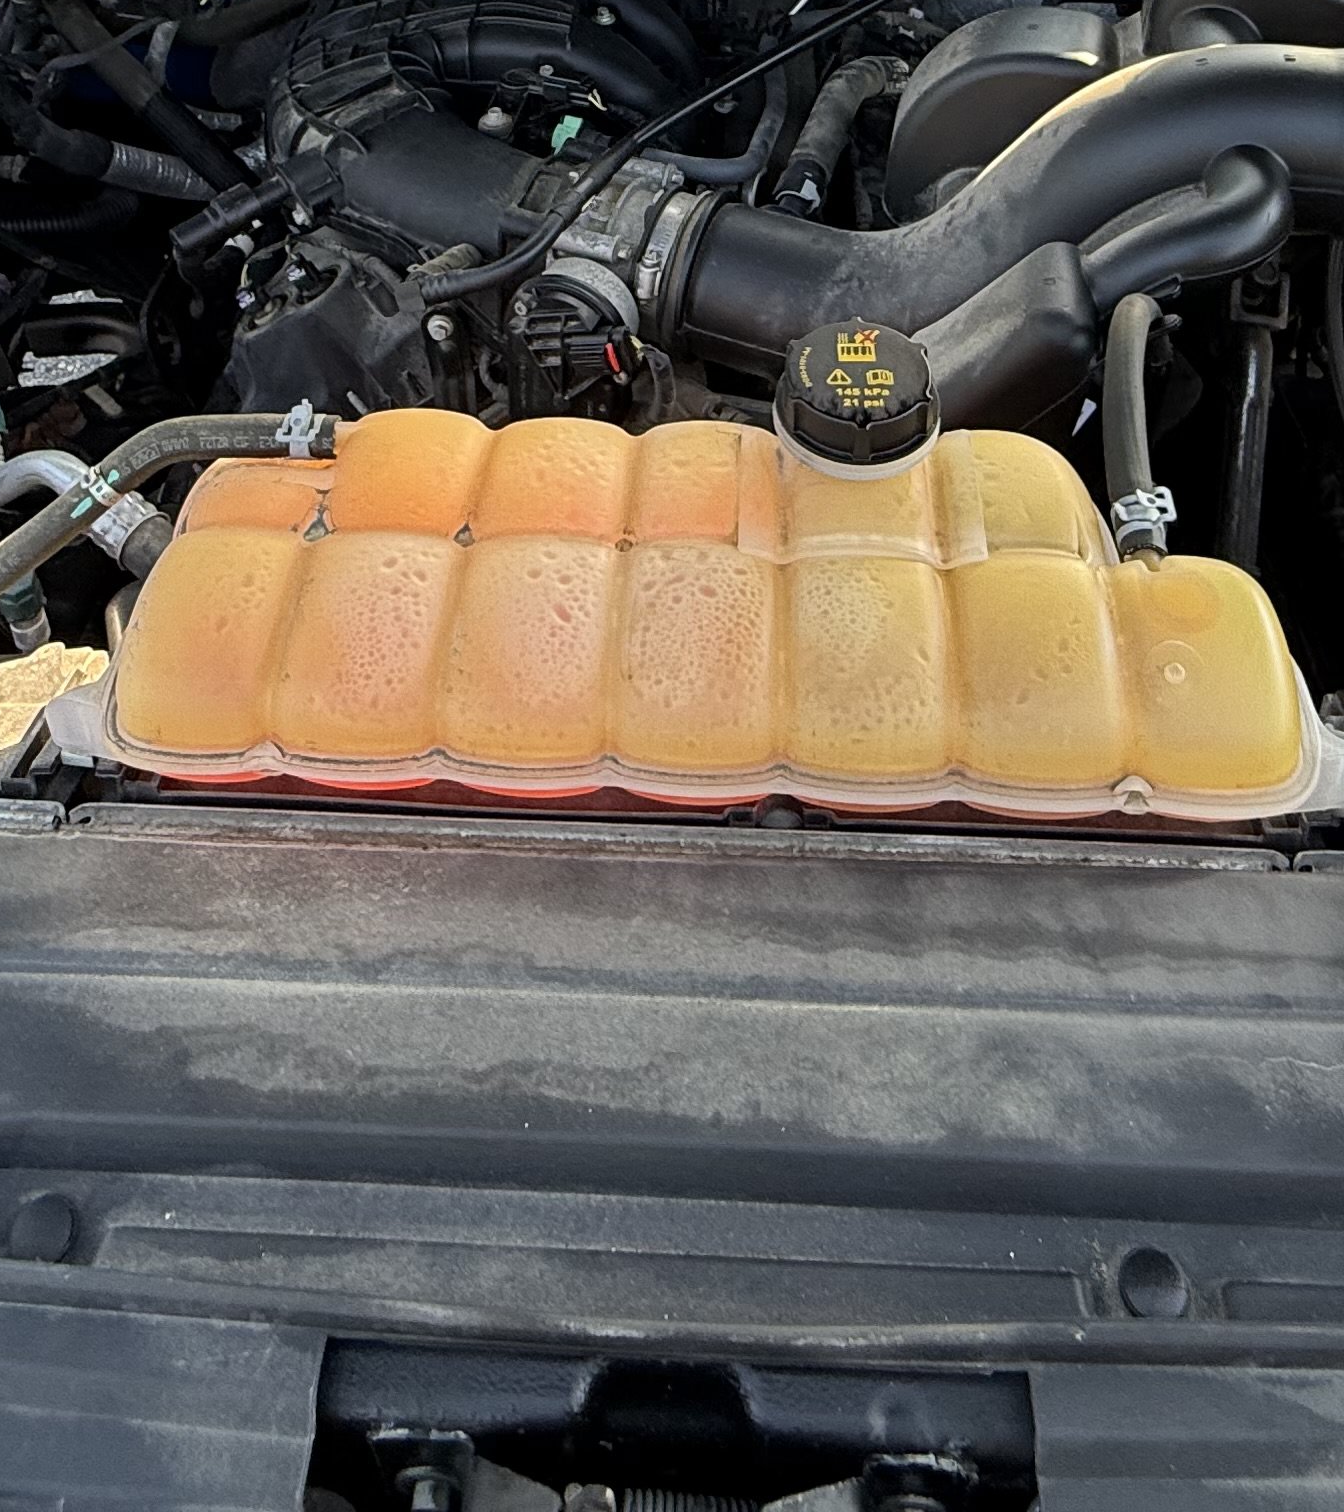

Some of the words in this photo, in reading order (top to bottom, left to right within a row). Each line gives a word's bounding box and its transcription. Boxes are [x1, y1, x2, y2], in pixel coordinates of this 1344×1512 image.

[835, 387, 861, 397] 145
[863, 387, 890, 397] kPa
[843, 398, 860, 408] 21
[863, 398, 885, 409] psi
